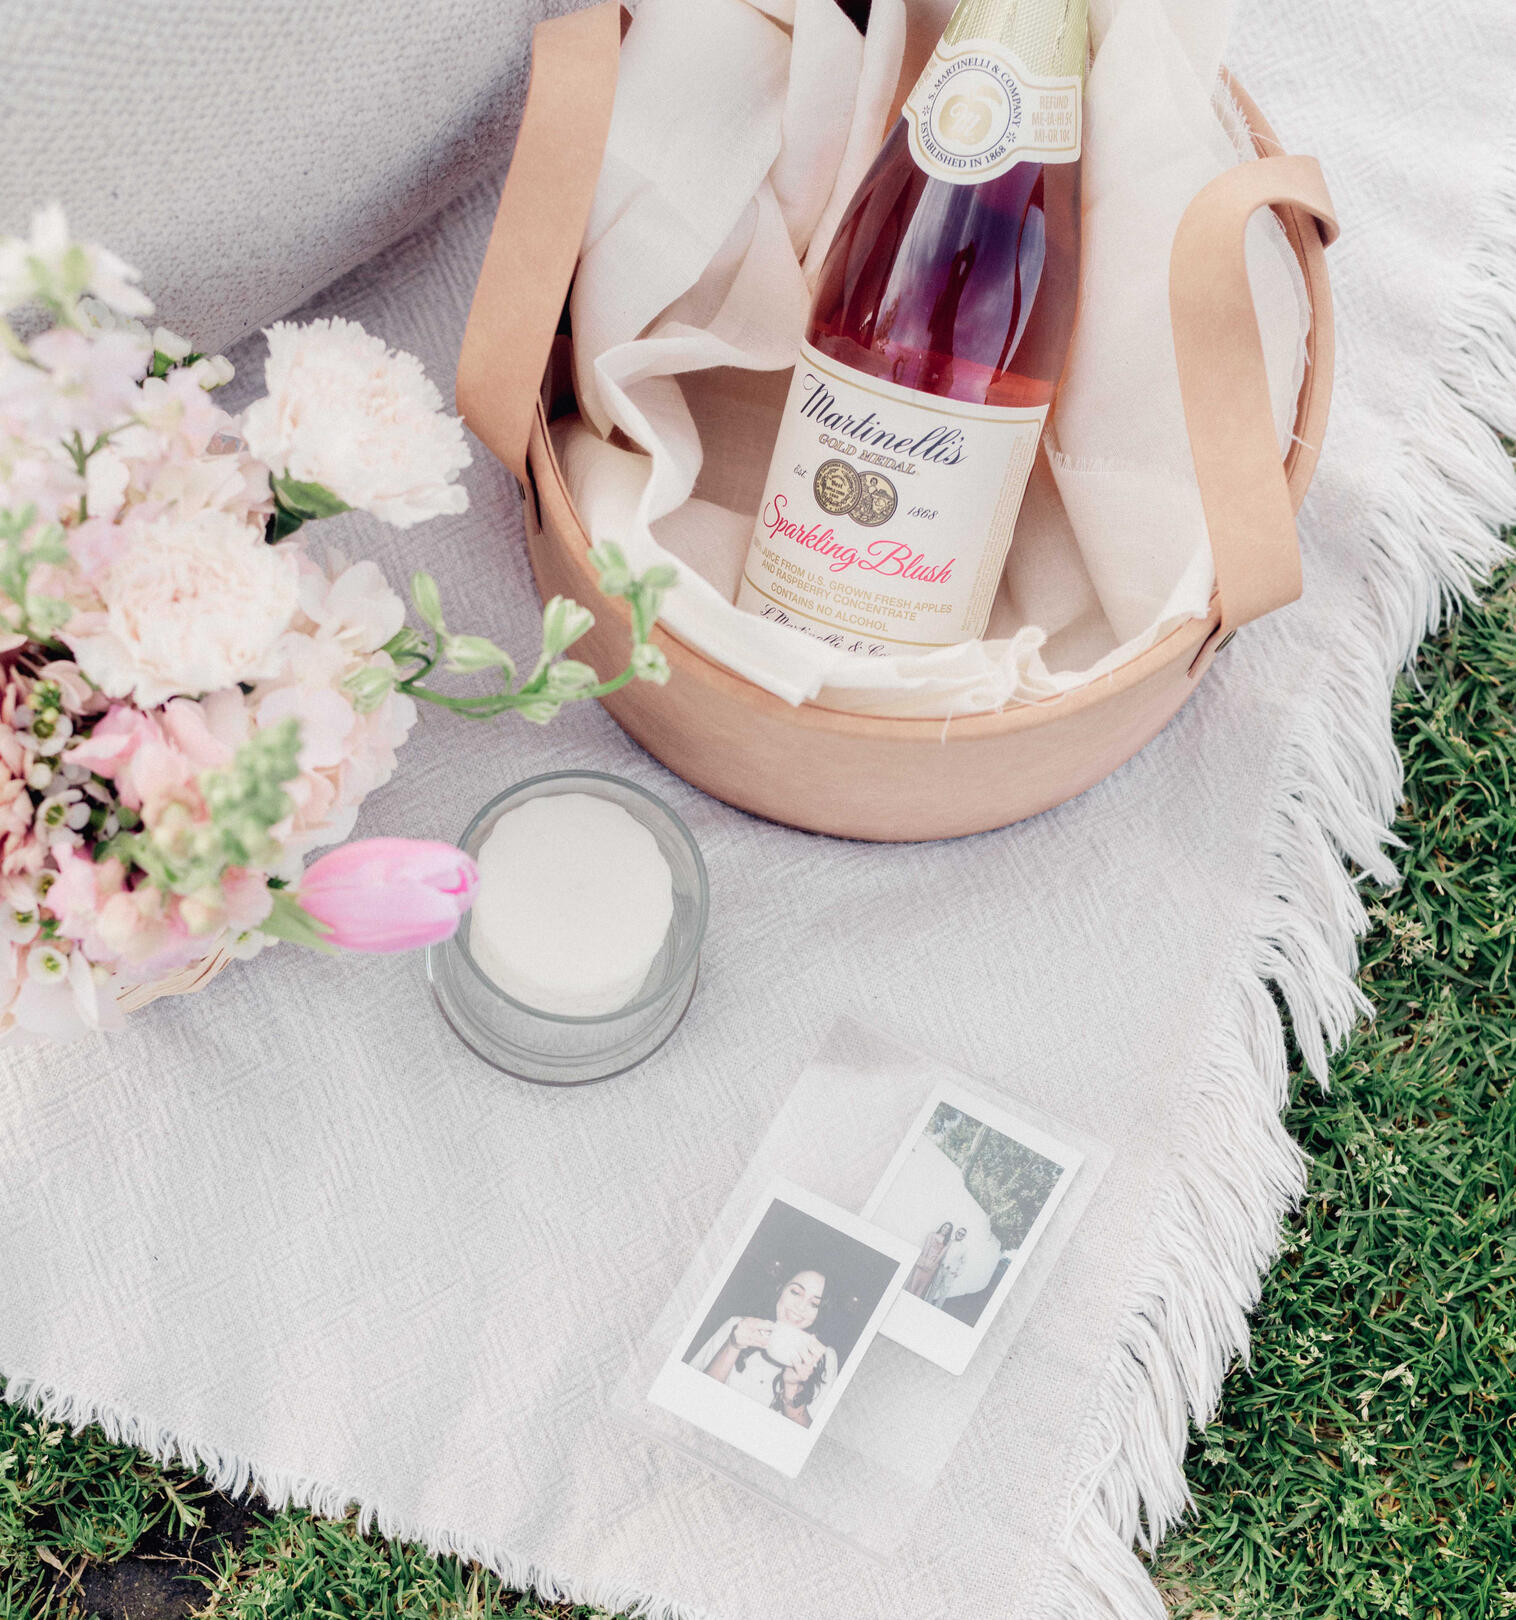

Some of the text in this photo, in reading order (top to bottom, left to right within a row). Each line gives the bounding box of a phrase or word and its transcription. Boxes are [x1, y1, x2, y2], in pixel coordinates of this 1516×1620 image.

[928, 92, 937, 101] S.
[934, 57, 991, 91] MARTINELLI
[991, 64, 1001, 74] &
[1000, 71, 1022, 128] COMPANY
[920, 121, 1007, 169] ESTABLISHED IN 1868
[800, 373, 969, 466] Martinelli's
[818, 433, 916, 475] GOLD MEDAL
[763, 494, 956, 584] Sparkling Blush
[906, 505, 940, 521] 1868
[761, 547, 953, 614] JUICE FROM U.S. GROWN FRESH APPLES
[761, 558, 918, 621] AND RASPBERRY CONCENTRATE
[770, 582, 889, 632] CONTAINS NO ALCOHOL
